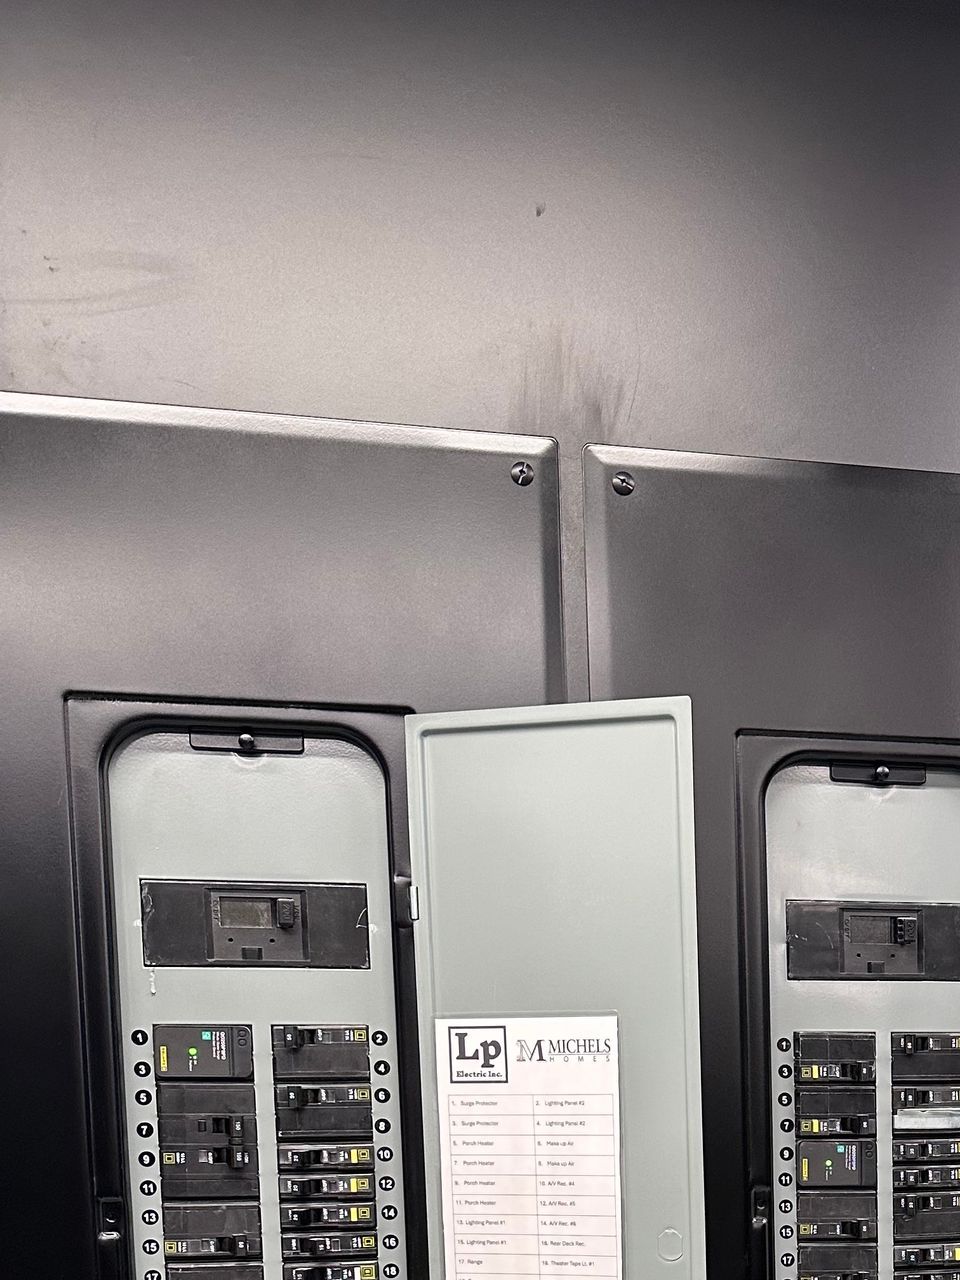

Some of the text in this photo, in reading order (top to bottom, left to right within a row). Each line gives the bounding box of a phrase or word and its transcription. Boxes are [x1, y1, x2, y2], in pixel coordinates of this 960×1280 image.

[136, 1032, 143, 1043] 1
[376, 1033, 383, 1043] 2
[548, 1038, 611, 1054] MICHELS
[781, 1041, 790, 1050] 1
[138, 1065, 146, 1075] 3
[378, 1063, 385, 1073] 4
[140, 1093, 147, 1103] 5
[378, 1091, 386, 1101] 6
[782, 1095, 788, 1104] 5
[141, 1125, 148, 1135] 7
[378, 1121, 386, 1131] 8
[378, 1149, 391, 1159] 10
[783, 1149, 789, 1159] 9
[142, 1154, 150, 1165] 9
[142, 1183, 154, 1193] 11
[380, 1179, 393, 1189] 12
[780, 1202, 791, 1211] 13
[143, 1212, 157, 1222] 13
[383, 1208, 395, 1218] 14
[781, 1228, 792, 1237] 15
[144, 1242, 157, 1252] 15
[384, 1266, 397, 1276] 18
